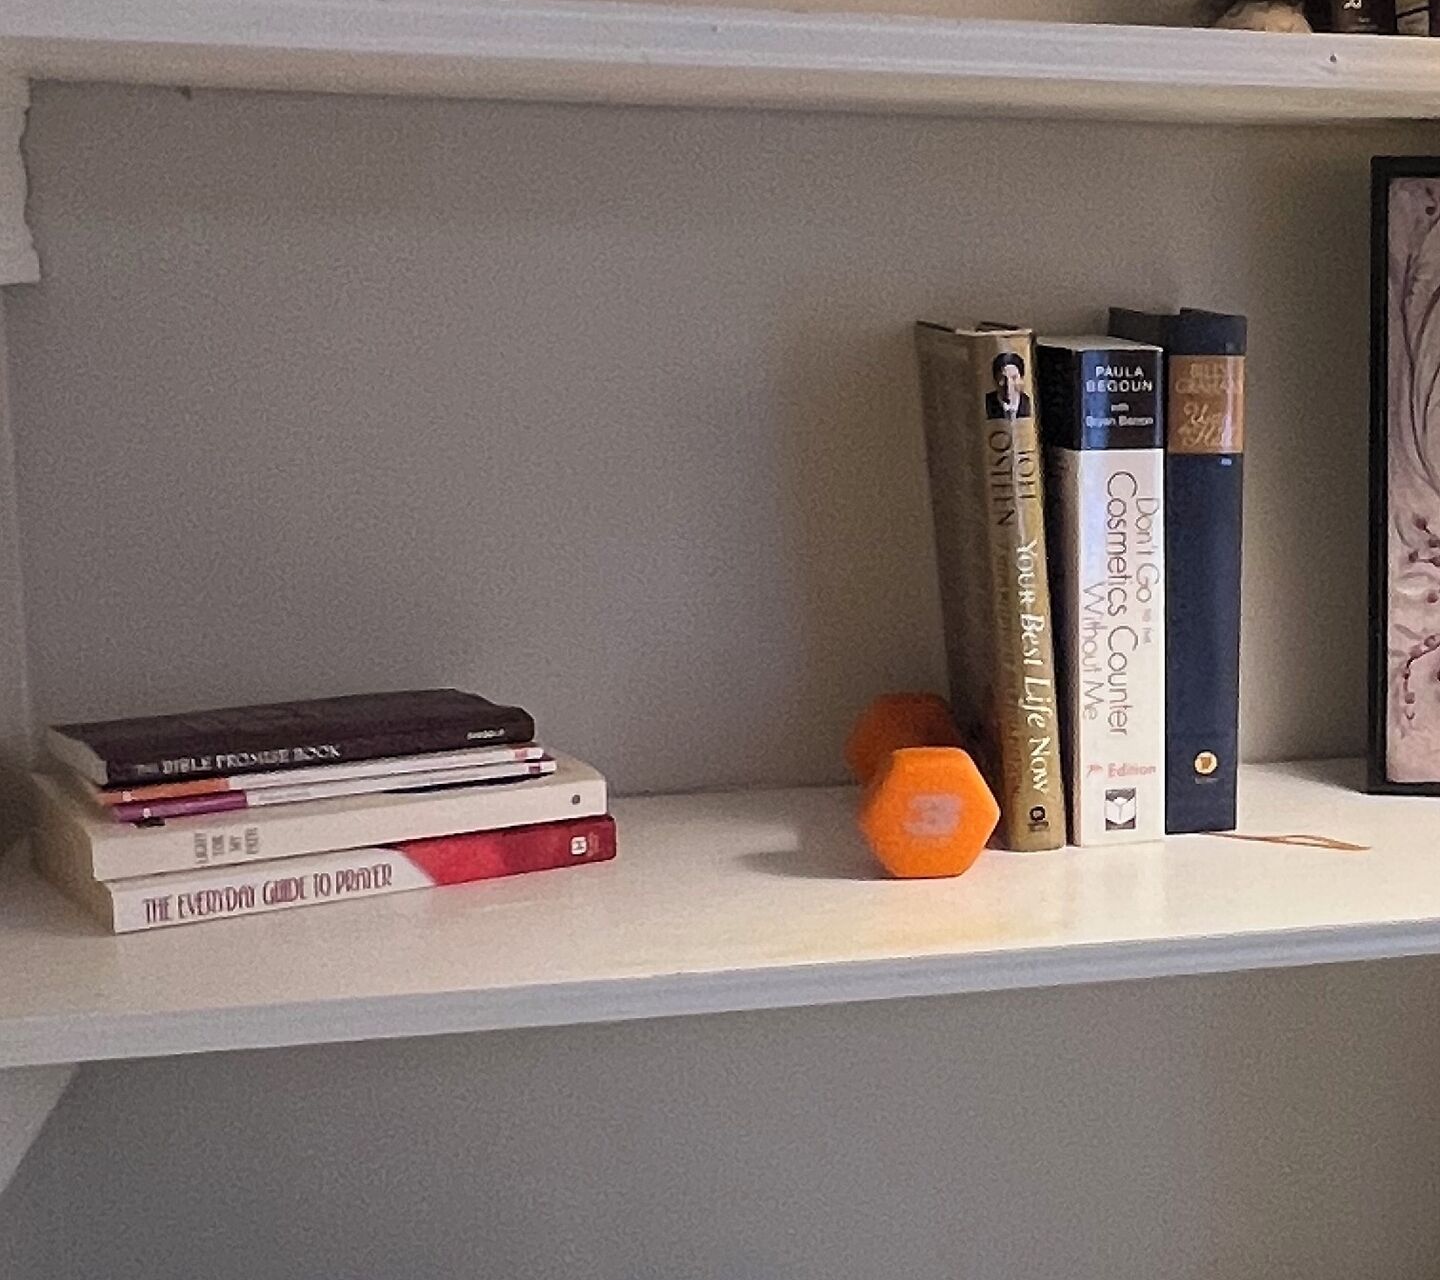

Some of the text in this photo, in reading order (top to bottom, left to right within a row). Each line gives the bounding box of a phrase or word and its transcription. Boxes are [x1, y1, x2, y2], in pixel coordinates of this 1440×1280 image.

[1086, 379, 1153, 392] BEGOUN
[1095, 365, 1145, 378] PAULA
[988, 430, 1016, 527] OSTEEN
[1135, 496, 1160, 556] Don't
[1107, 471, 1139, 737] Cosmetics Counter
[1135, 562, 1160, 603] Go
[1082, 580, 1109, 722] Without Me
[1018, 675, 1052, 729] Life
[162, 758, 213, 775] BIBLE
[216, 748, 291, 769] PROMISE
[293, 744, 342, 762] BOOK
[1108, 762, 1157, 778] Edition
[143, 862, 394, 925] THE EVERYDAY GUIDE TO PRAYER
